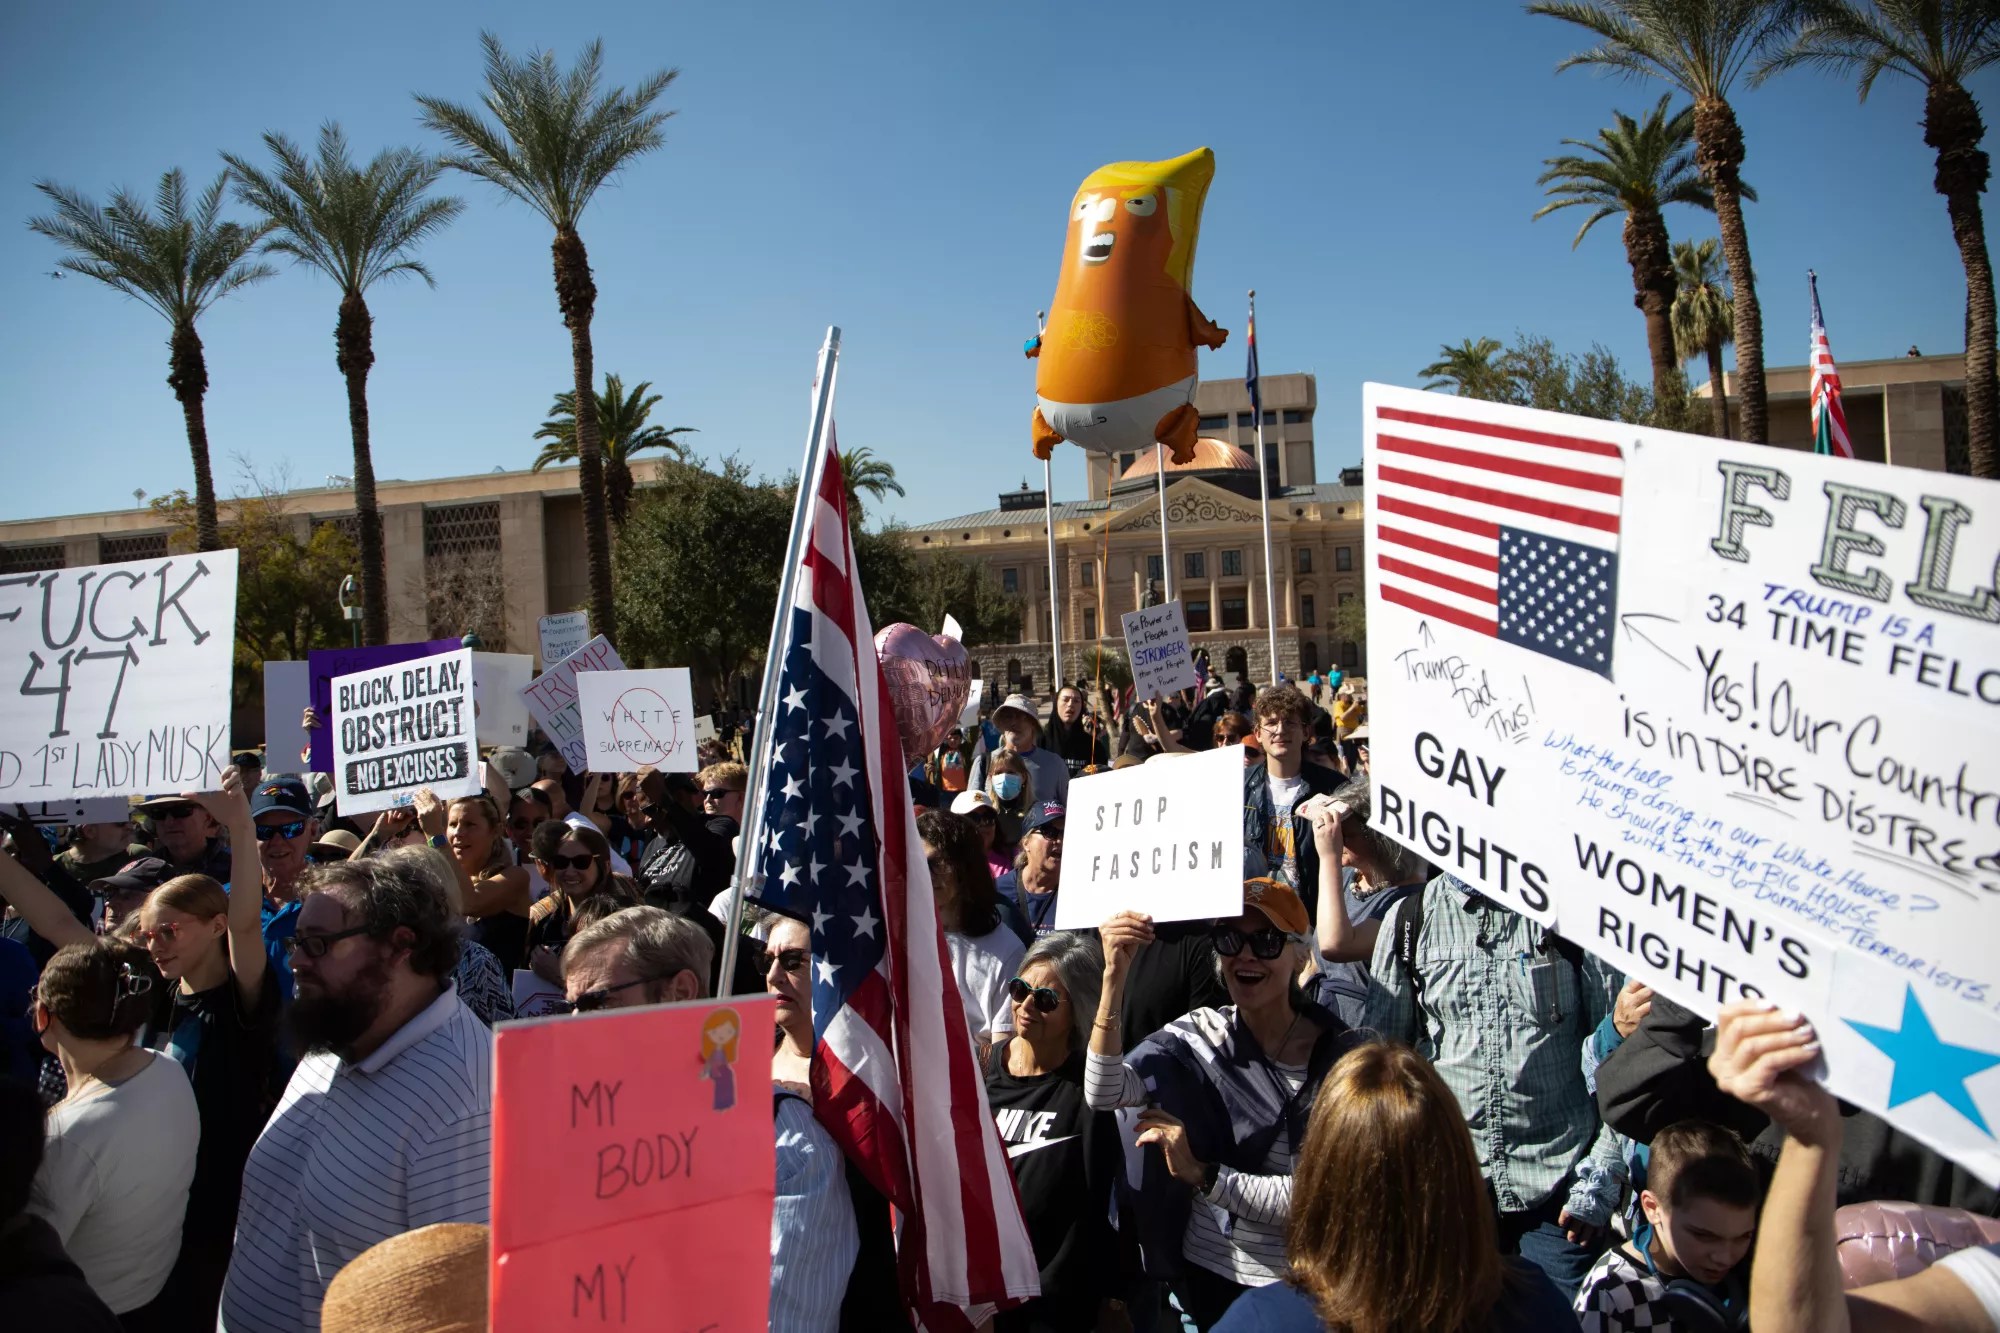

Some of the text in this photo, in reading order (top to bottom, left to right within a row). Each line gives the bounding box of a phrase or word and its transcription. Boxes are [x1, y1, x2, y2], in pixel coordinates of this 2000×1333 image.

[1711, 460, 2000, 623] FEL
[1140, 615, 1162, 630] Power
[1706, 594, 1748, 631] 34
[1768, 608, 1867, 667] TIME
[1764, 583, 1872, 626] TRUMP
[1914, 622, 1936, 648] A
[1135, 641, 1186, 667] STRONGER
[1394, 648, 1470, 692] Trump
[20, 641, 139, 739] 47
[340, 675, 398, 713] BLOCK,
[402, 660, 465, 700] DELAY,
[1451, 668, 1498, 719] Did
[1696, 644, 1760, 730] Yes!
[1770, 678, 1842, 754] Our
[341, 695, 465, 755] OBSTRUCT
[602, 710, 681, 724] WHITE
[72, 740, 141, 789] LADY
[145, 724, 225, 789] MUSK
[357, 747, 457, 792] NO EXCUSES
[600, 740, 684, 753] SUPREMACY
[1414, 731, 1507, 808] GAY
[1094, 796, 1168, 832] STOP
[1731, 827, 1773, 849] our
[1091, 840, 1223, 882] FASCISM
[1380, 783, 1550, 914] RIGHTS
[1806, 883, 1881, 932] HOUSE
[571, 1080, 623, 1128] MY
[996, 1108, 1057, 1142] NIKE
[596, 1126, 699, 1199] BODY
[571, 1255, 636, 1323] MY
